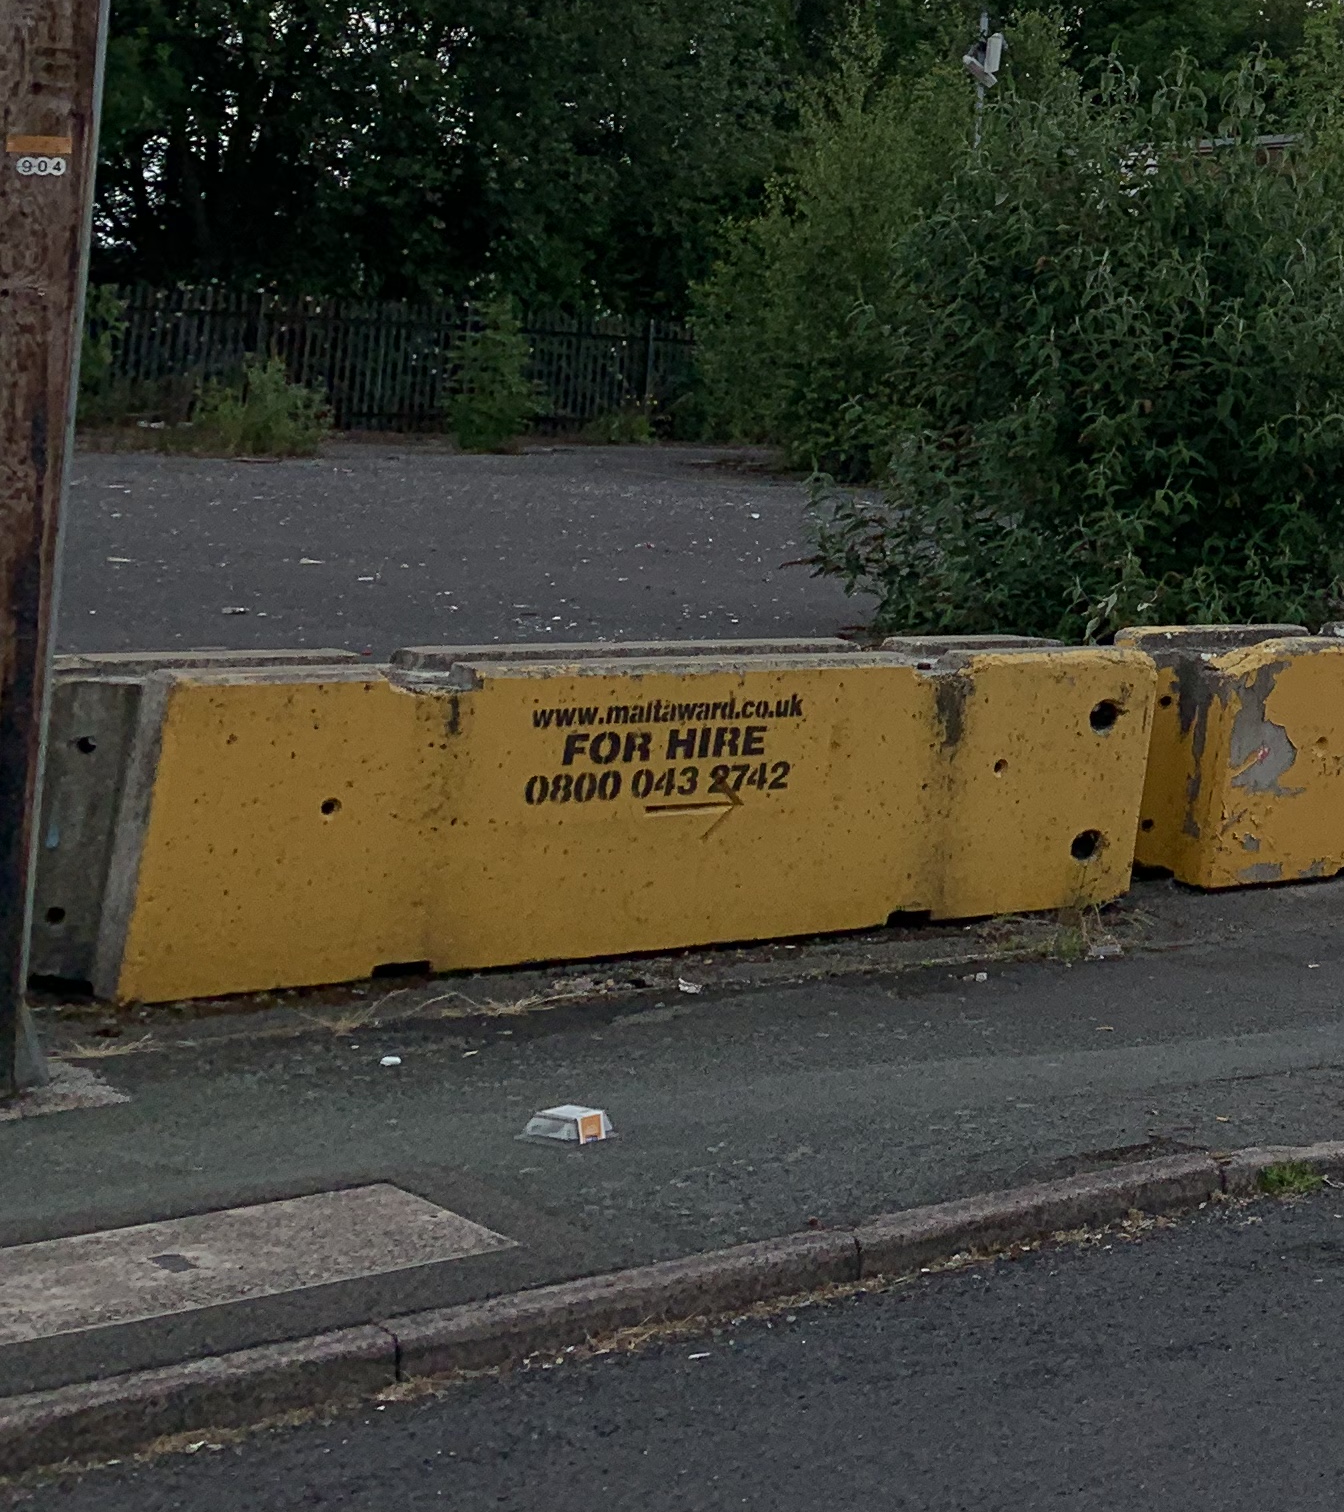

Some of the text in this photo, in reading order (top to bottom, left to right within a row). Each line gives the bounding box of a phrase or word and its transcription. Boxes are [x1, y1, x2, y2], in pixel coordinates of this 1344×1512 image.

[21, 159, 62, 173] 904
[532, 693, 804, 728] www.maltaward.co.uk
[562, 726, 767, 766] FOR HIRE
[524, 761, 791, 806] 0800 043 2742
